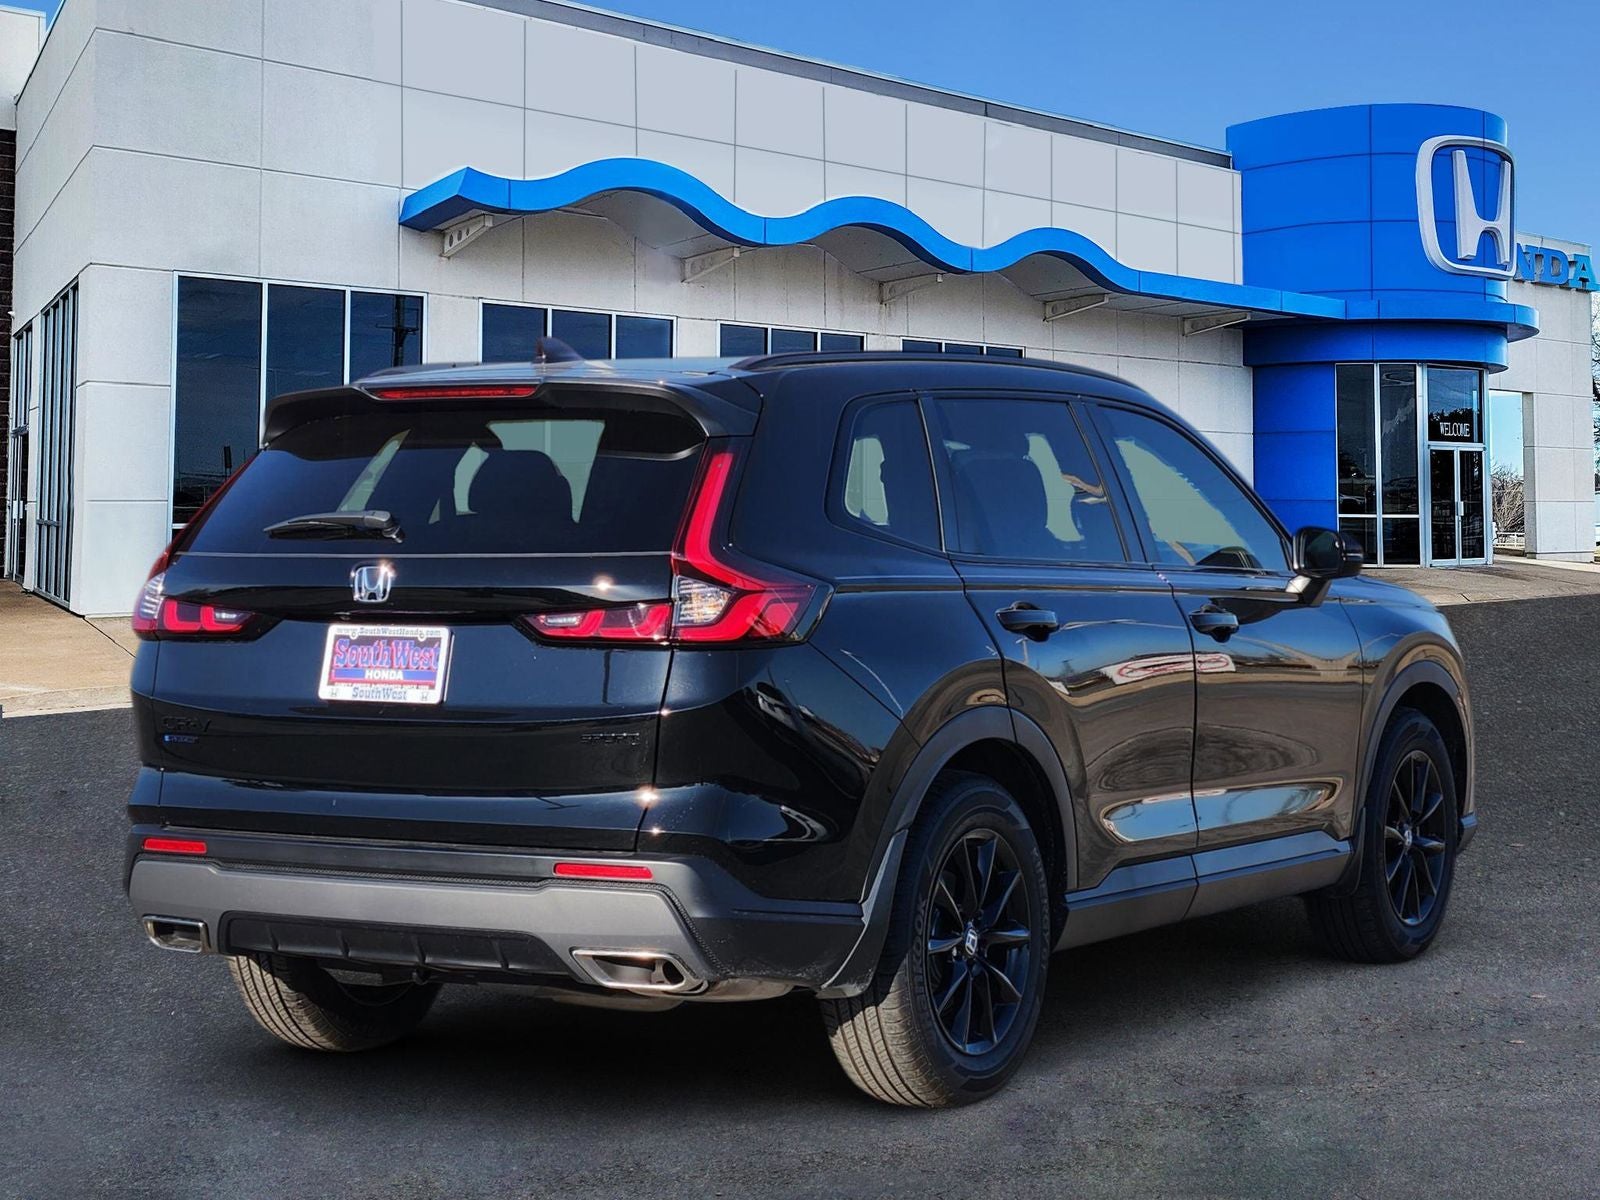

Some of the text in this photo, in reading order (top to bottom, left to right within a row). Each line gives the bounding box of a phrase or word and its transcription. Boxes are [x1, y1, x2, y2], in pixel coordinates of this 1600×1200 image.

[1514, 243, 1600, 291] NDA
[1440, 422, 1470, 437] WELCOME
[364, 668, 404, 680] HONDA
